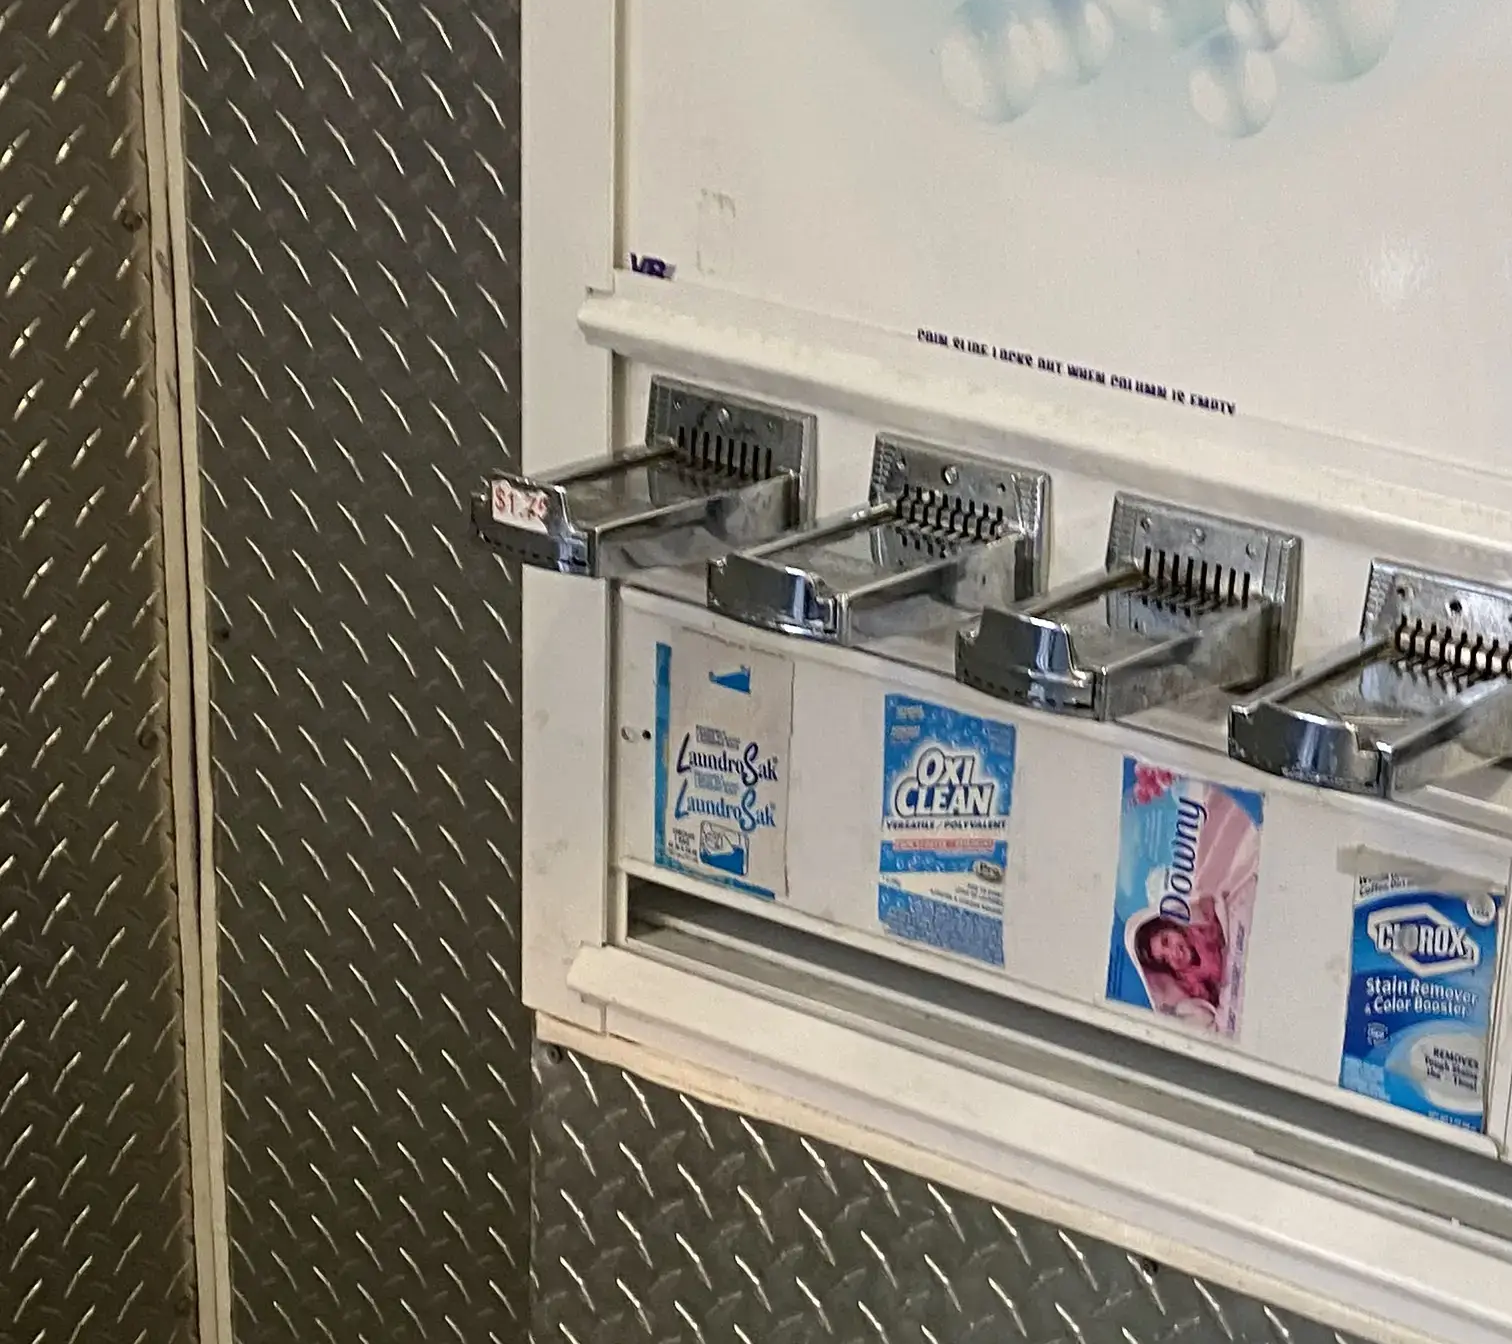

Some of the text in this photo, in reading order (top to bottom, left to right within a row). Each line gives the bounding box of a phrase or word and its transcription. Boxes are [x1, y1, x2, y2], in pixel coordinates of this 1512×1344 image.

[916, 746, 976, 787] OXI
[894, 776, 995, 818] CLEAN
[1159, 795, 1208, 924] Downy
[1365, 975, 1479, 1007] Stain Remover
[1373, 994, 1412, 1015] Color
